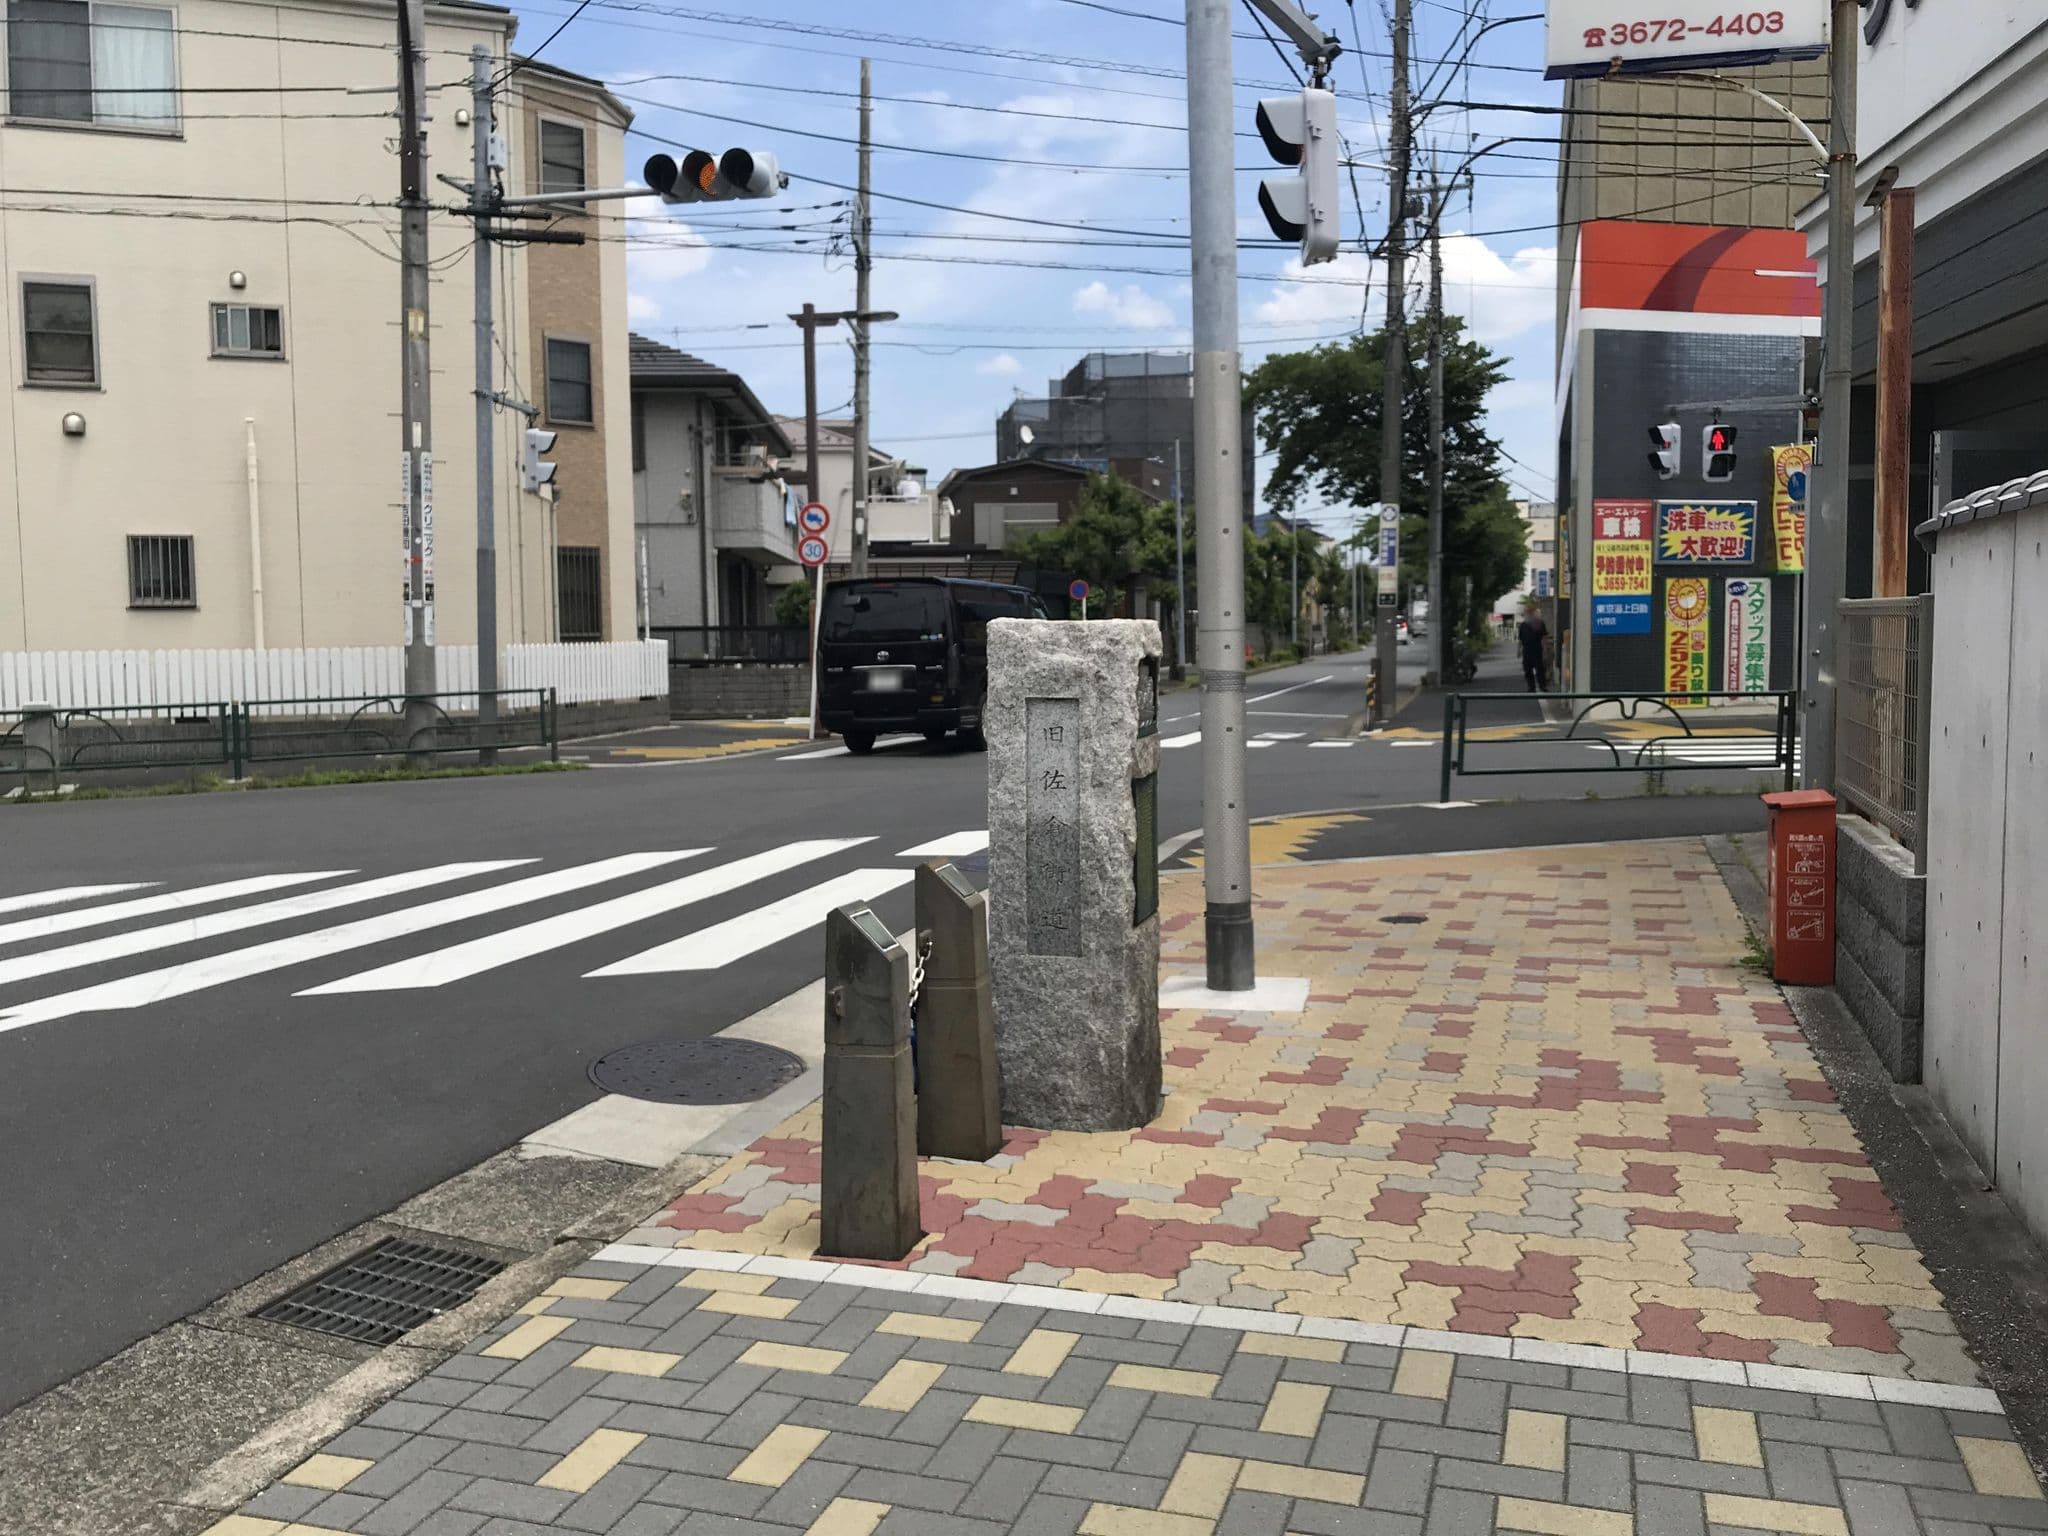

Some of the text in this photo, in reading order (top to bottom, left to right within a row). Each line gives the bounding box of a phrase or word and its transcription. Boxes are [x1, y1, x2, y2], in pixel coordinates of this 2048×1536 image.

[1610, 11, 1784, 46] 3672-4403
[1602, 517, 1641, 538] 車検
[1668, 510, 1736, 532] 洗車だけでも
[805, 544, 821, 557] 30
[1745, 581, 1766, 701] スタッフ募集中
[1041, 725, 1069, 930] 旧佐倉街道
